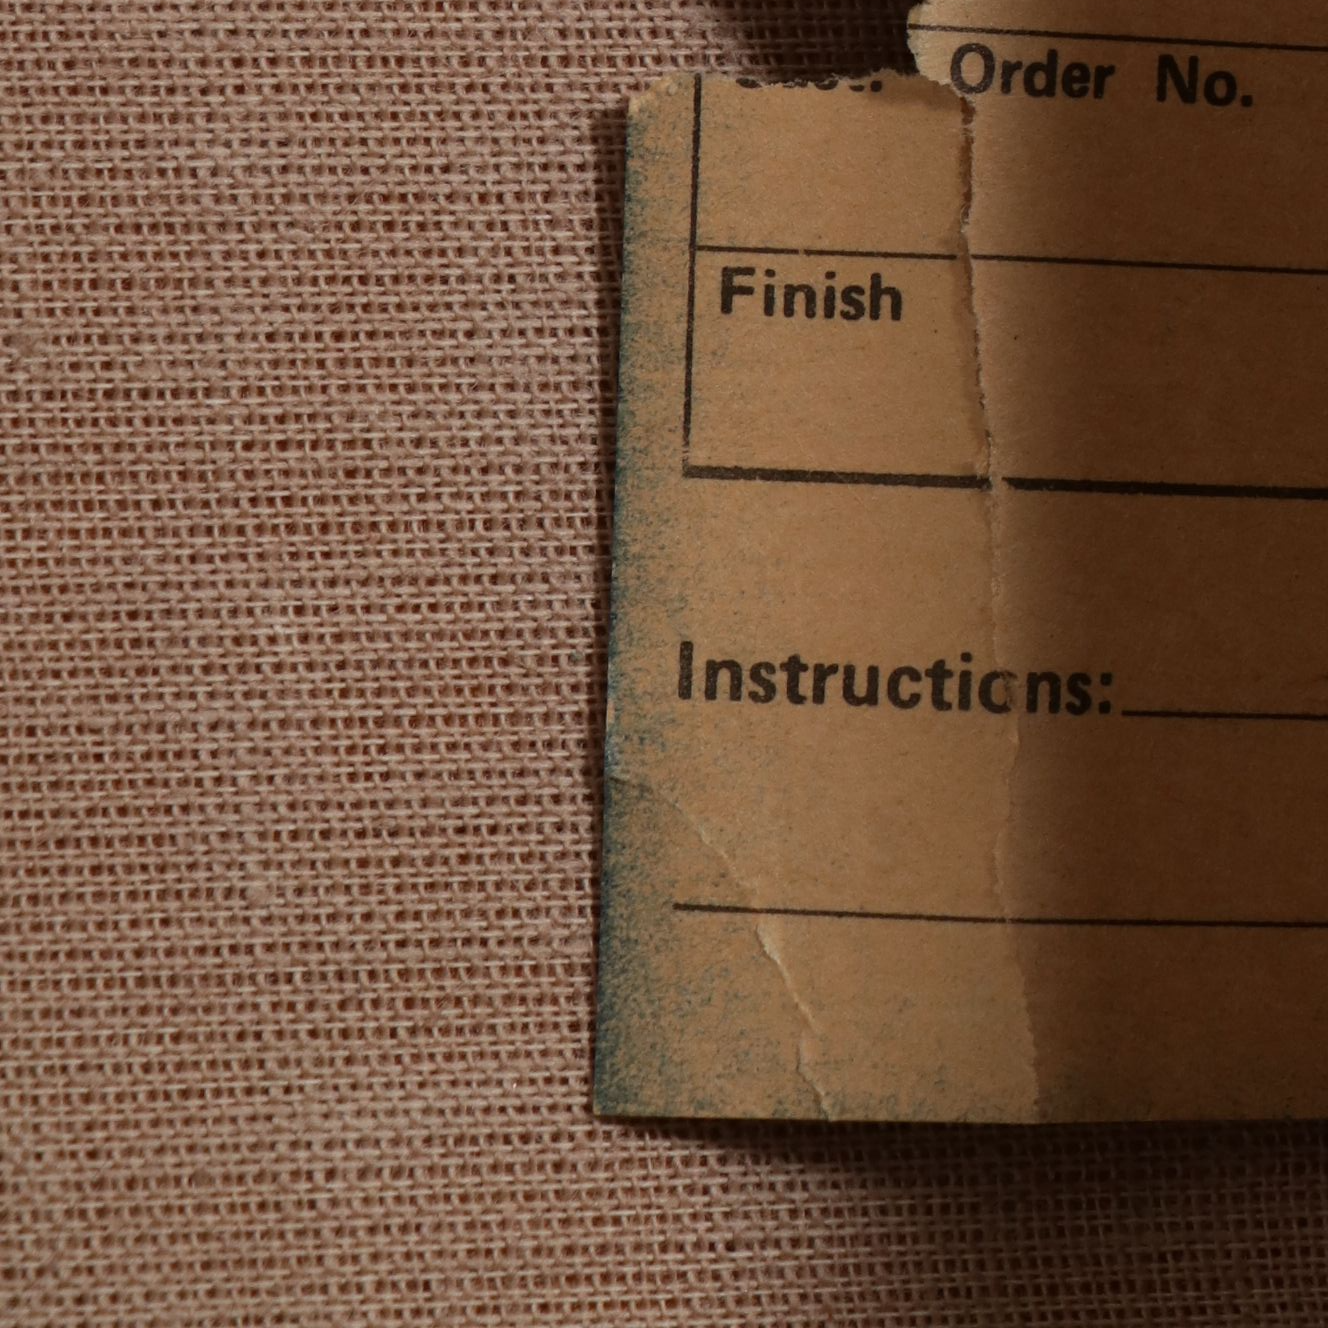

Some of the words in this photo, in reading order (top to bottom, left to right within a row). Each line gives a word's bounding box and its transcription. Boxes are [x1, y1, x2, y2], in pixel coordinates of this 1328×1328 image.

[950, 43, 1115, 100] Order
[1156, 54, 1254, 107] No.
[720, 266, 903, 322] Finish
[677, 641, 1113, 716] Instructions:
